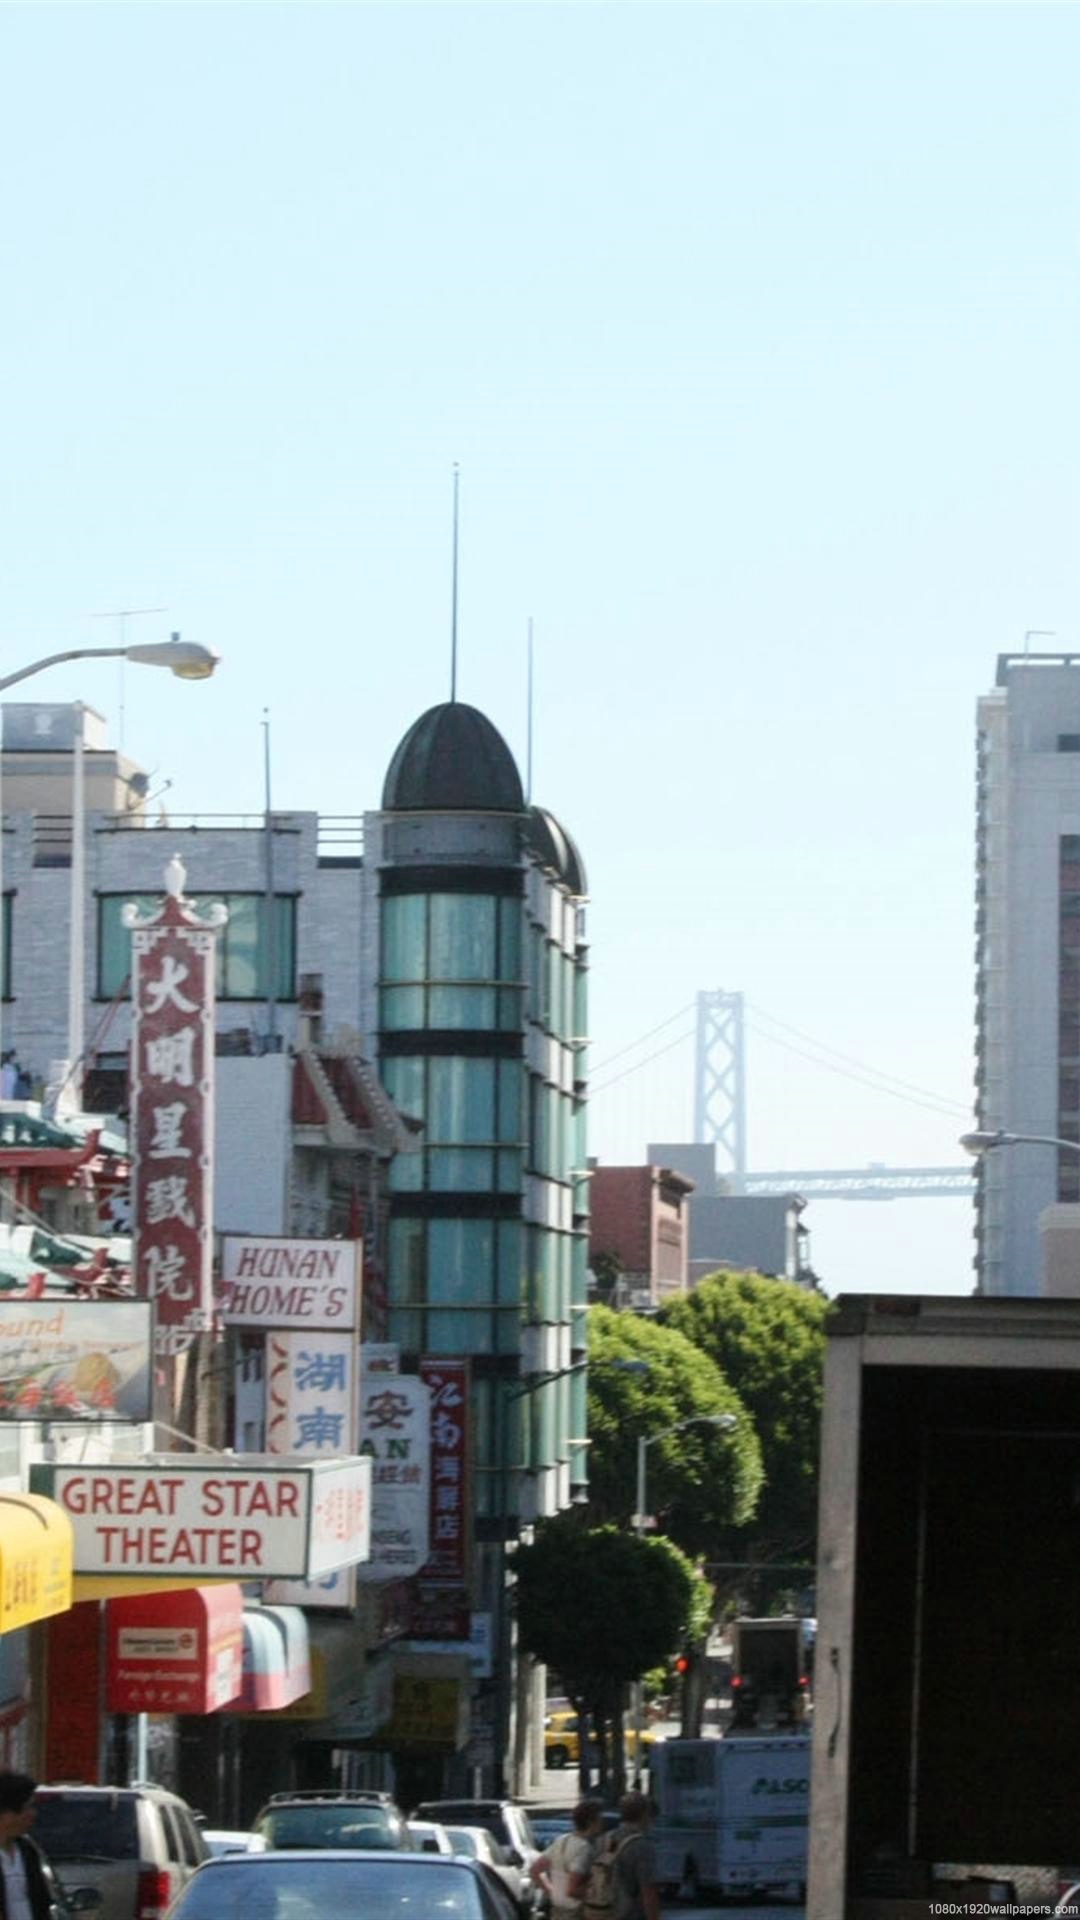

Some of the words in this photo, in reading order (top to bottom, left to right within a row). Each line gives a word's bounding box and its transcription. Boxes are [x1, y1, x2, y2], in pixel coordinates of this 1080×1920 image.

[235, 1246, 341, 1279] HUNAN
[227, 1284, 347, 1317] HOME'S
[62, 1479, 192, 1516] GREAT
[201, 1479, 299, 1518] STAR
[96, 1527, 264, 1567] THEATER
